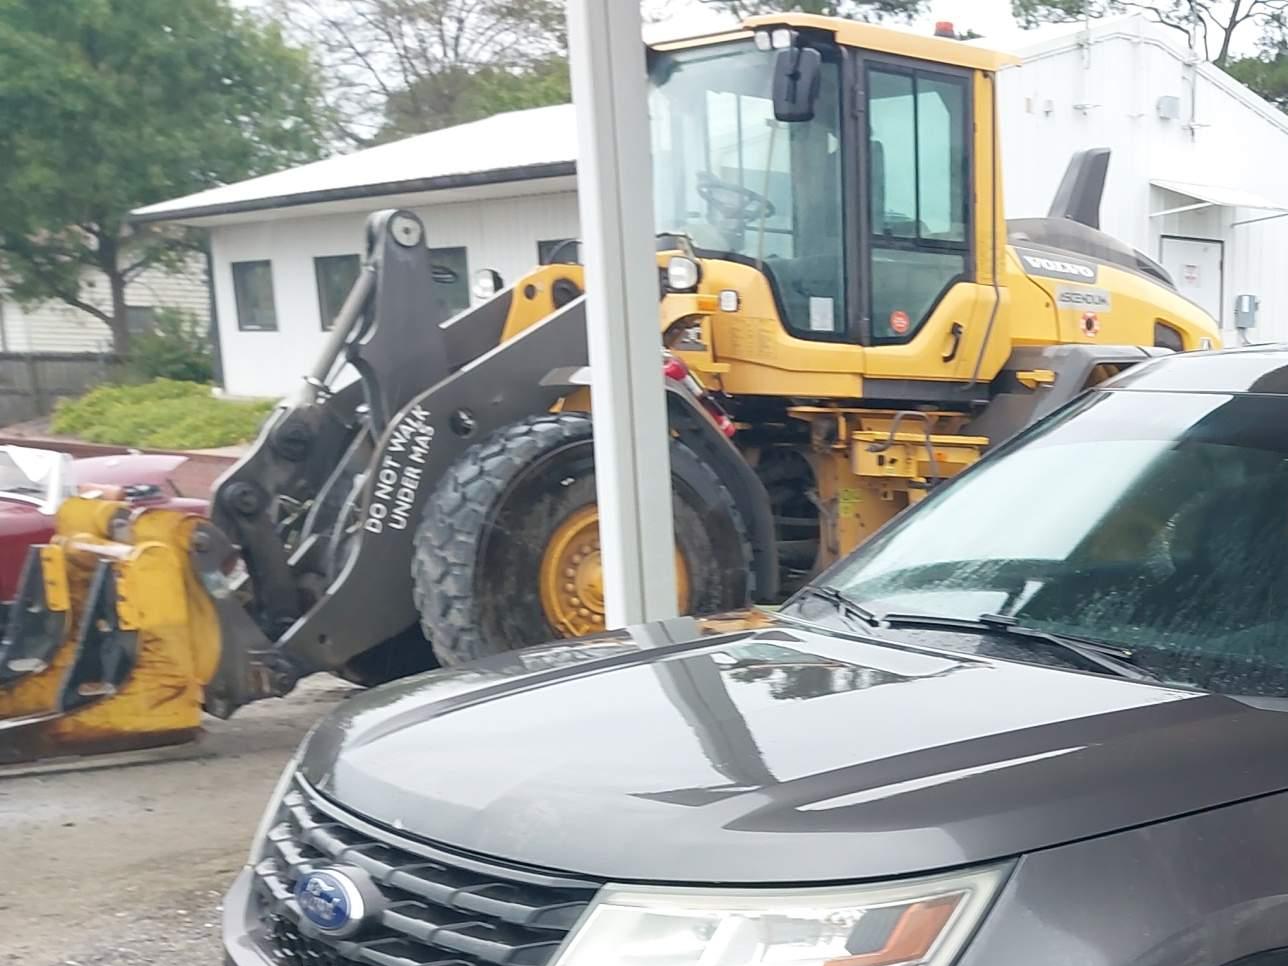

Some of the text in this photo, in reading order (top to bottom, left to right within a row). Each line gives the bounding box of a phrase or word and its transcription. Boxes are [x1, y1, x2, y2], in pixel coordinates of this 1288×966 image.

[1022, 255, 1095, 278] VOLVO
[364, 404, 432, 534] DO NOT WALK
[388, 466, 424, 530] UNDER
